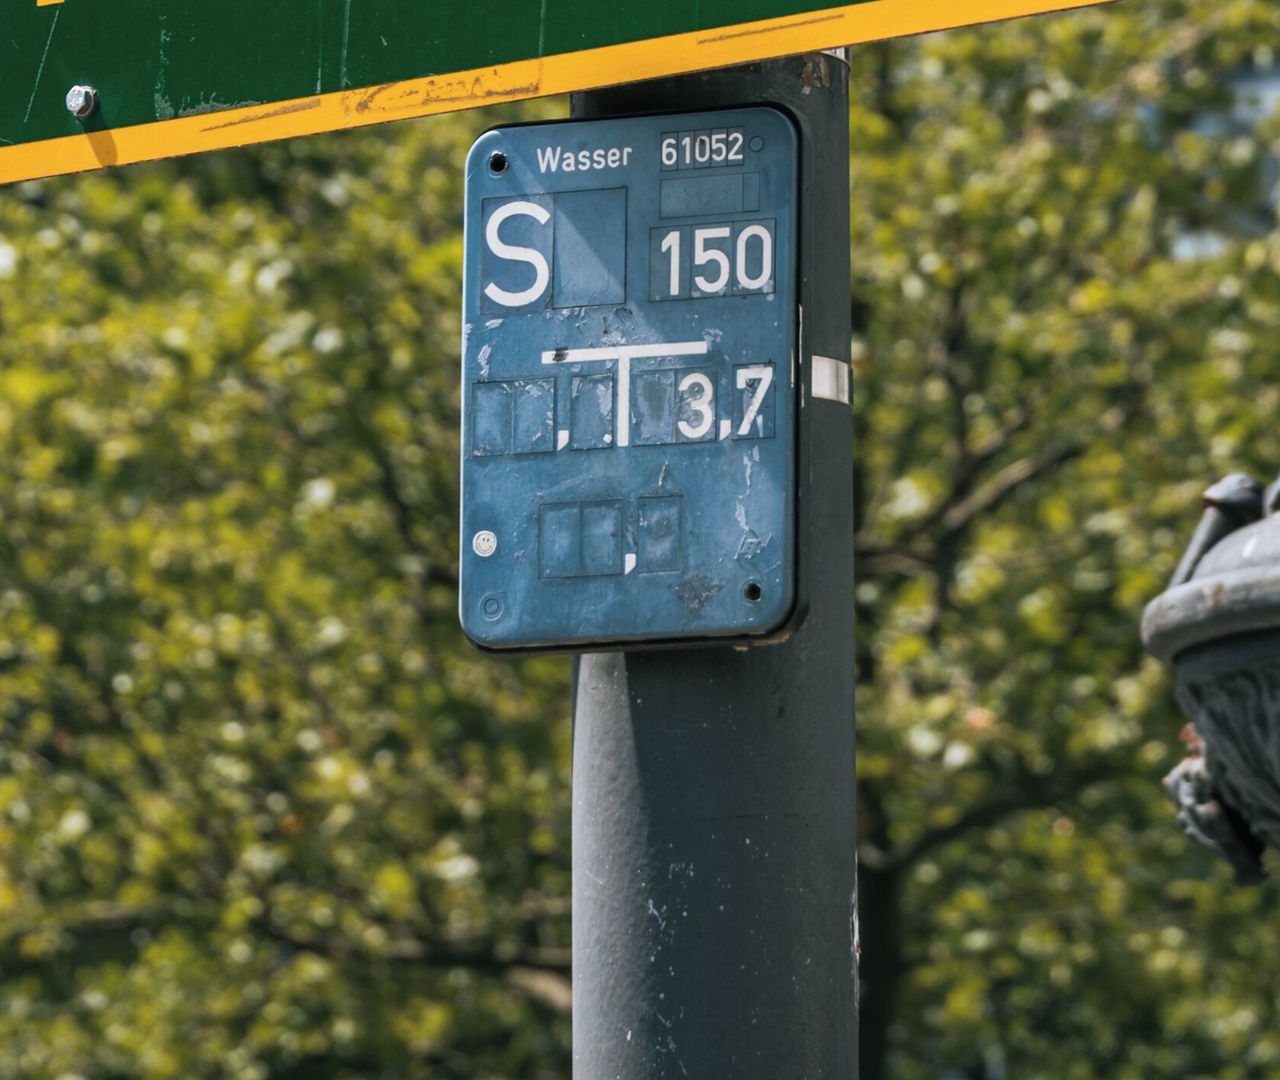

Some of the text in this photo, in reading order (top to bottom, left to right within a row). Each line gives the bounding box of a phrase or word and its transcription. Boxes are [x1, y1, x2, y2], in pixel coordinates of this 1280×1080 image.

[536, 132, 744, 174] Wasser 61052
[483, 200, 773, 308] S 150
[677, 363, 774, 441] 3,7
